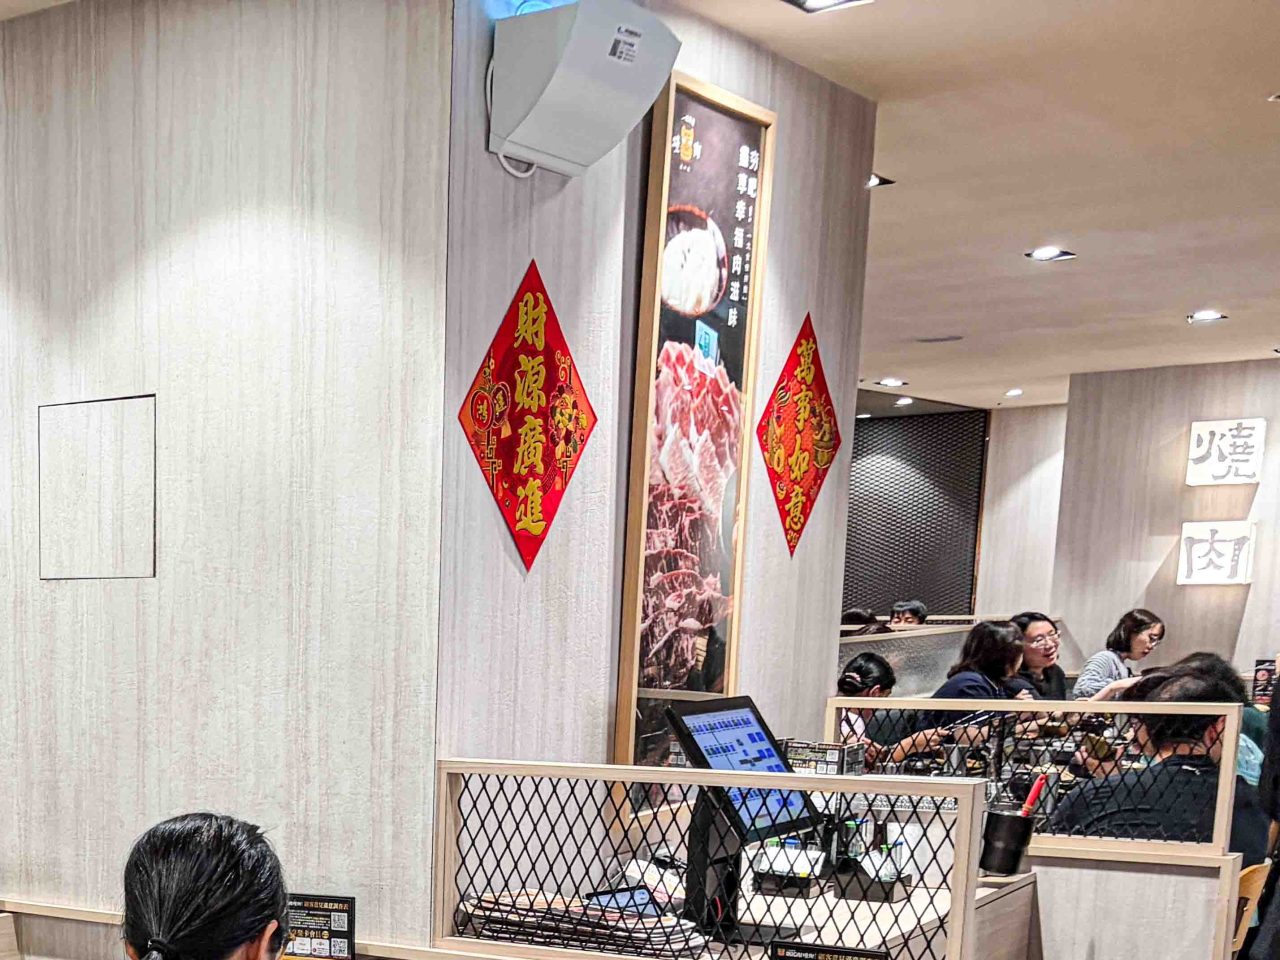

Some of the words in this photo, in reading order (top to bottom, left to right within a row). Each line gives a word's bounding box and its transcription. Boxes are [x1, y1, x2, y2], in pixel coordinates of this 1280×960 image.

[513, 291, 549, 536] 財源廣進
[783, 337, 818, 532] 萬事如意
[1185, 421, 1257, 580] 燒肉
